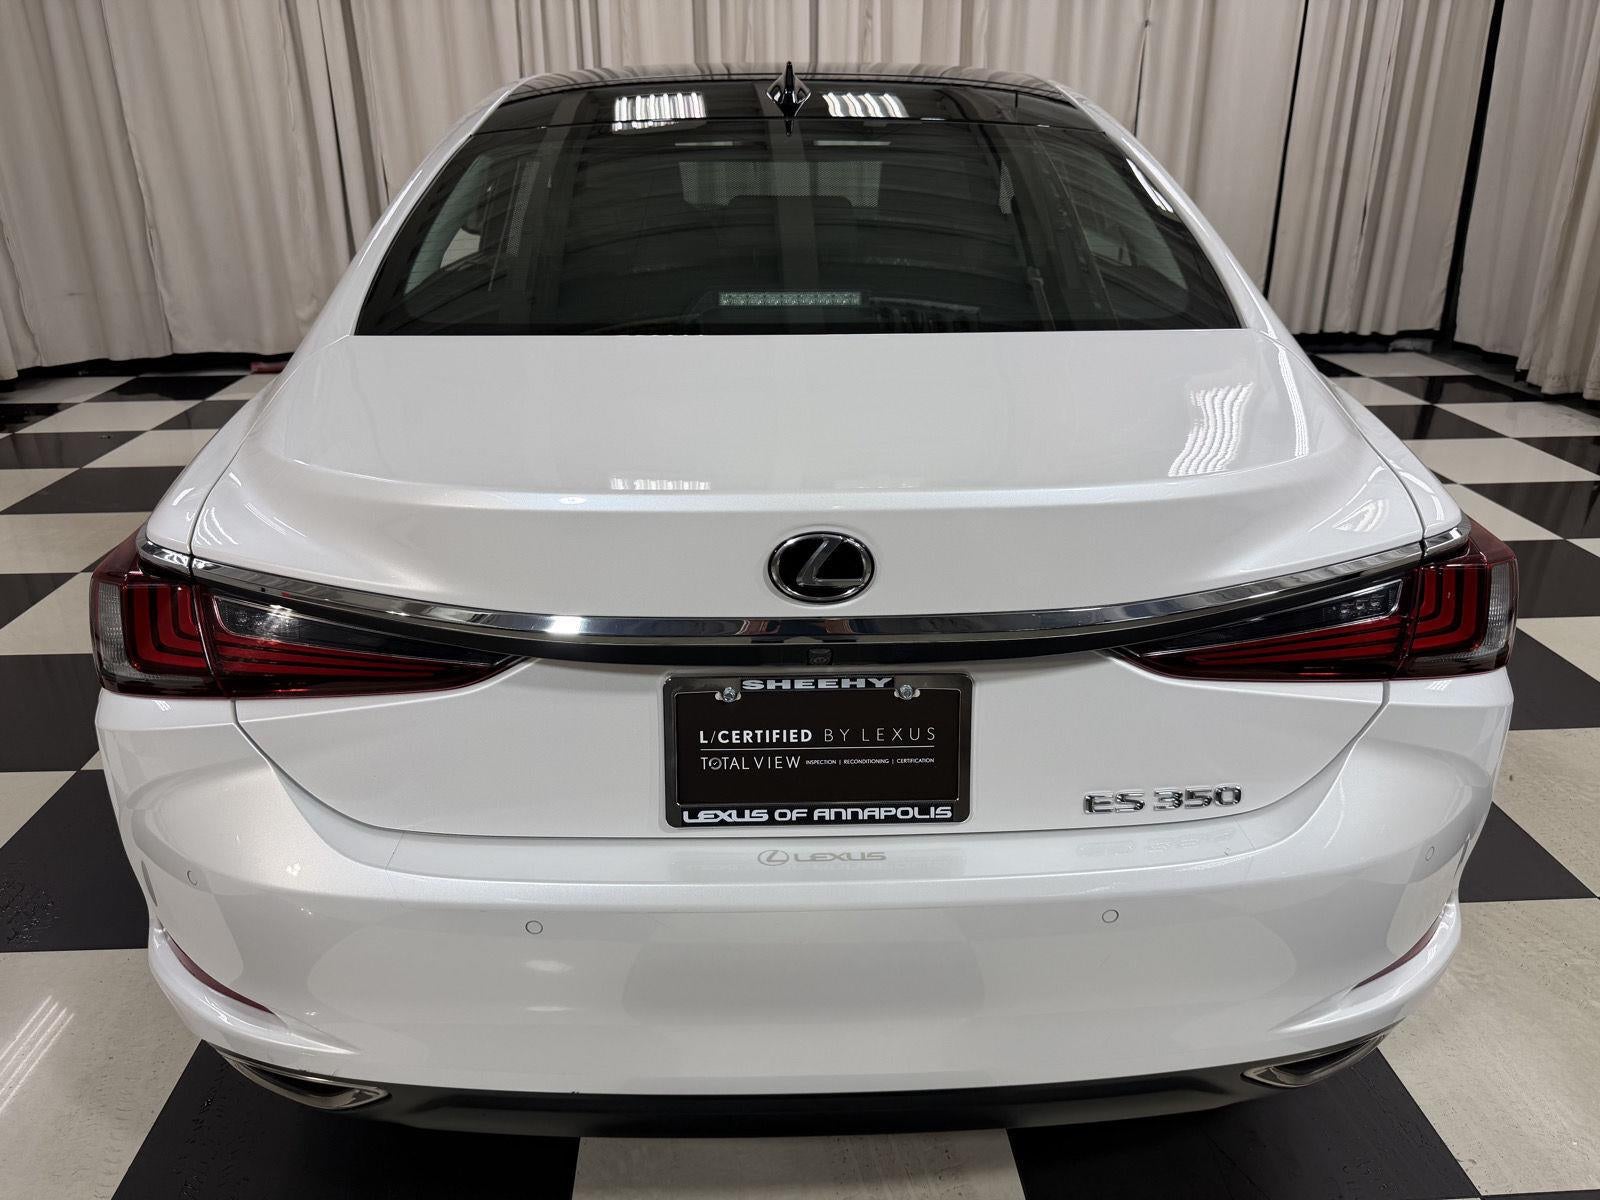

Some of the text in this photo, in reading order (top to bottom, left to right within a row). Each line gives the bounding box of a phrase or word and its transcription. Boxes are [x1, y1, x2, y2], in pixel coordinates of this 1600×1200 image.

[742, 678, 892, 689] SHEEHY
[699, 727, 936, 743] L/CERTIFIED BY LEXUS
[701, 756, 750, 770] TOTAL
[754, 756, 801, 769] VIEW
[1084, 783, 1242, 814] ES 350
[682, 806, 953, 823] LEXUS OF ANNAPOLIS
[794, 851, 887, 862] LEXUS
